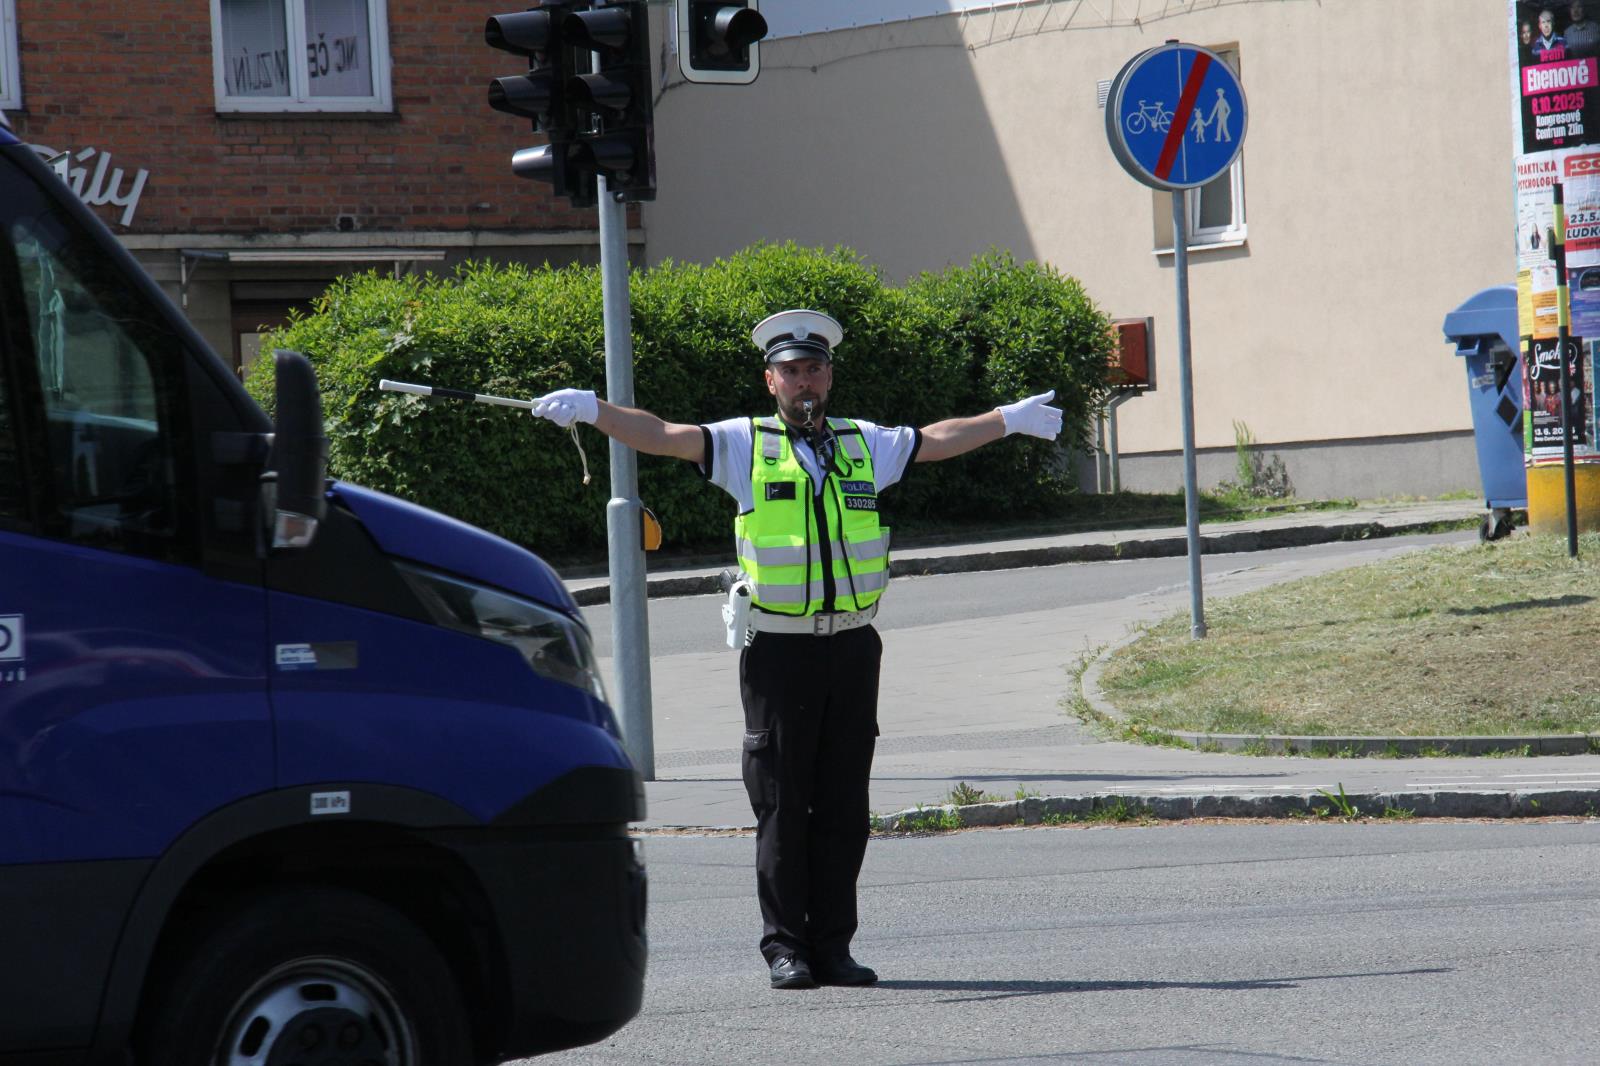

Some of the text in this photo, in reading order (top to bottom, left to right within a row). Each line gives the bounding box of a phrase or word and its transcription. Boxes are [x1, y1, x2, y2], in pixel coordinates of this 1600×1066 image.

[1527, 60, 1589, 92] Ebenové
[1532, 92, 1584, 115] 8.10.2025
[1536, 109, 1581, 127] Kongresové
[1535, 123, 1584, 140] Centrum Zlín
[848, 498, 876, 510] 330285
